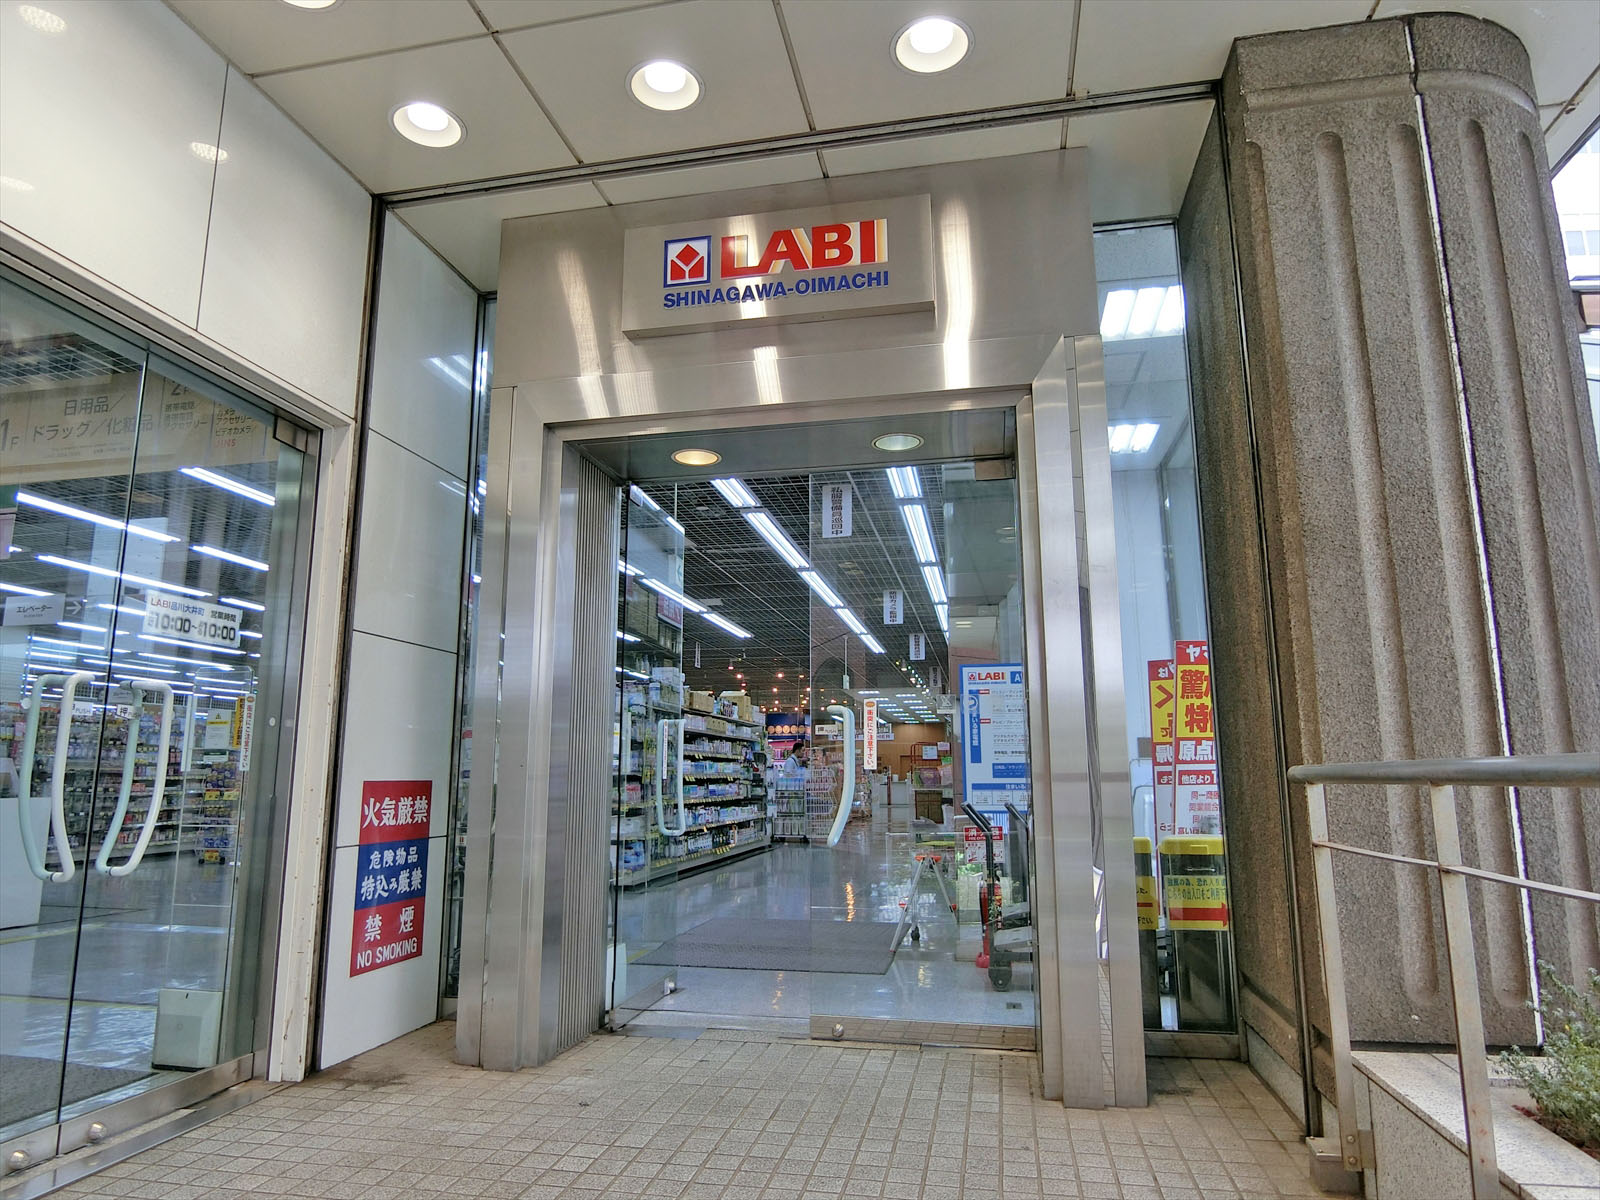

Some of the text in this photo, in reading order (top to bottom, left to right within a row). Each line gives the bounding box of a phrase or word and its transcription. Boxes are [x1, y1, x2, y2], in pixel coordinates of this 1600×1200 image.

[720, 218, 889, 280] LABI
[663, 271, 889, 308] SHINAGAWA-OIMACHI
[977, 671, 1006, 681] LABI
[1178, 740, 1216, 761] 原点
[362, 796, 428, 828] 火気厳禁
[368, 846, 419, 871] 危険物品
[361, 868, 422, 901] 持込み厳禁
[356, 937, 418, 970] NO SMOKING
